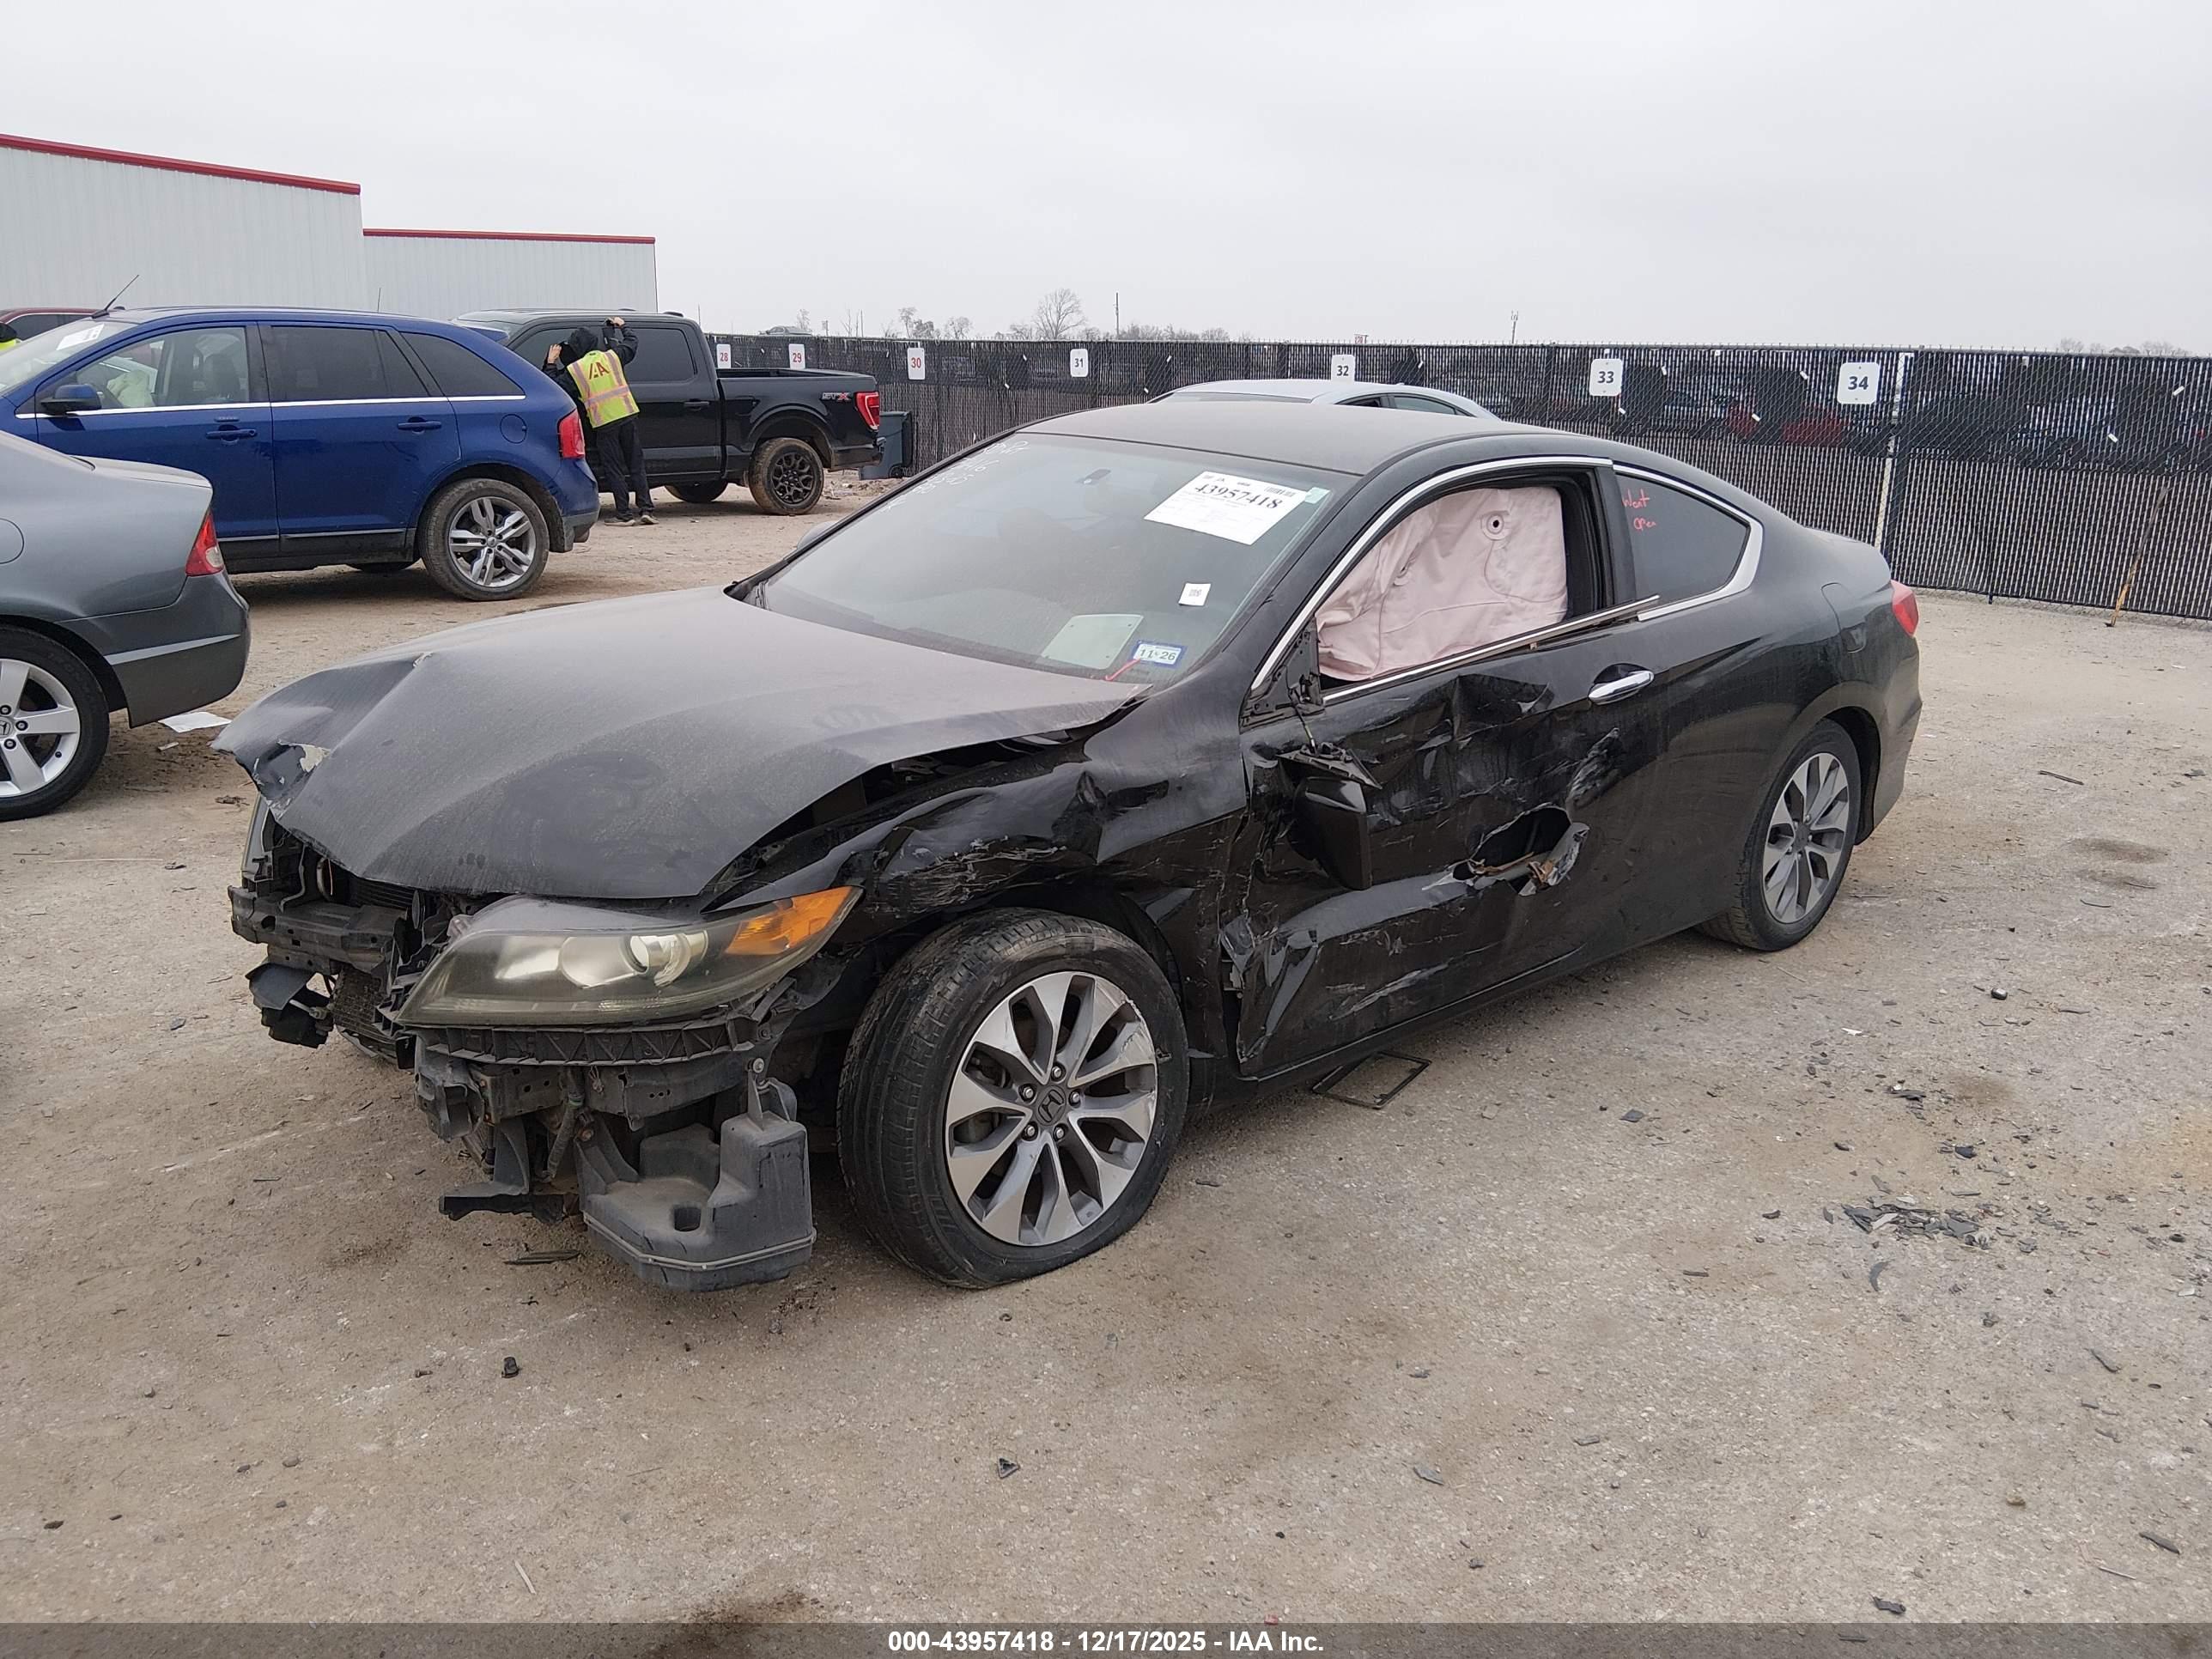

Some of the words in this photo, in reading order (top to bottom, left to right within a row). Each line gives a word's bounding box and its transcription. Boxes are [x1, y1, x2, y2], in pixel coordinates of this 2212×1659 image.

[720, 352, 729, 362] 28
[793, 352, 802, 363] 29
[910, 357, 921, 368] 30
[1074, 357, 1084, 368] 31
[1336, 365, 1350, 377] 32
[1597, 370, 1614, 384] 33
[1847, 375, 1869, 391] 34
[1194, 483, 1283, 509] 43957418
[1159, 651, 1176, 660] 26
